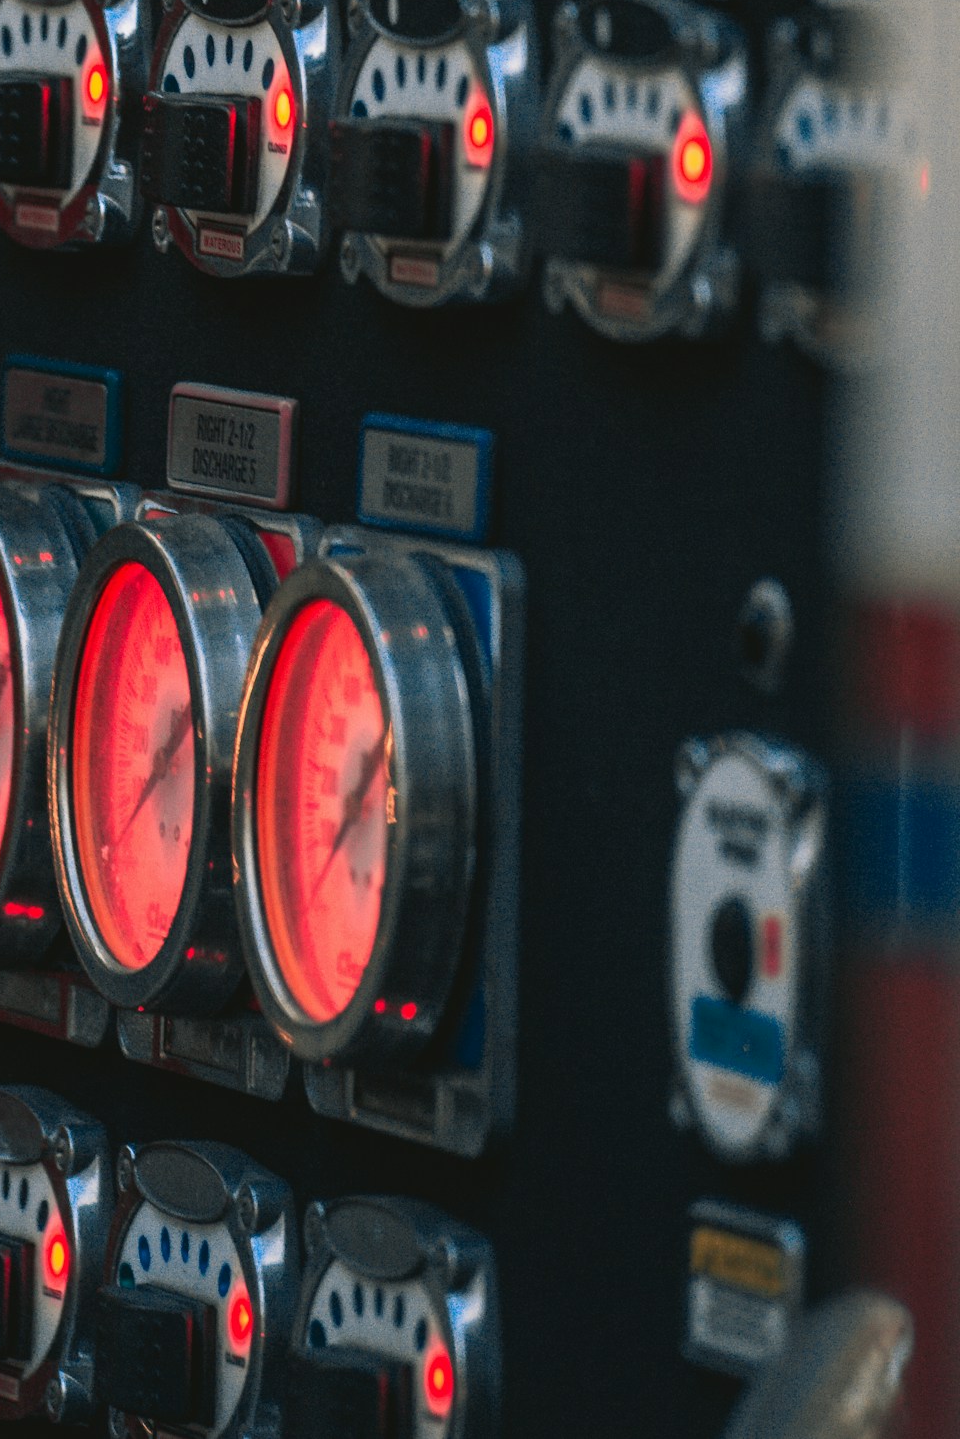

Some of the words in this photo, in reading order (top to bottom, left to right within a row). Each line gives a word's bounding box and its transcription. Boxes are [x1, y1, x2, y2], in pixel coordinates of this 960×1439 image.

[203, 235, 243, 255] WATEROUS
[196, 413, 226, 445] RIGHT
[227, 418, 256, 451] 2-1/2
[192, 447, 248, 484] DISCHARGE
[248, 457, 257, 486] 5
